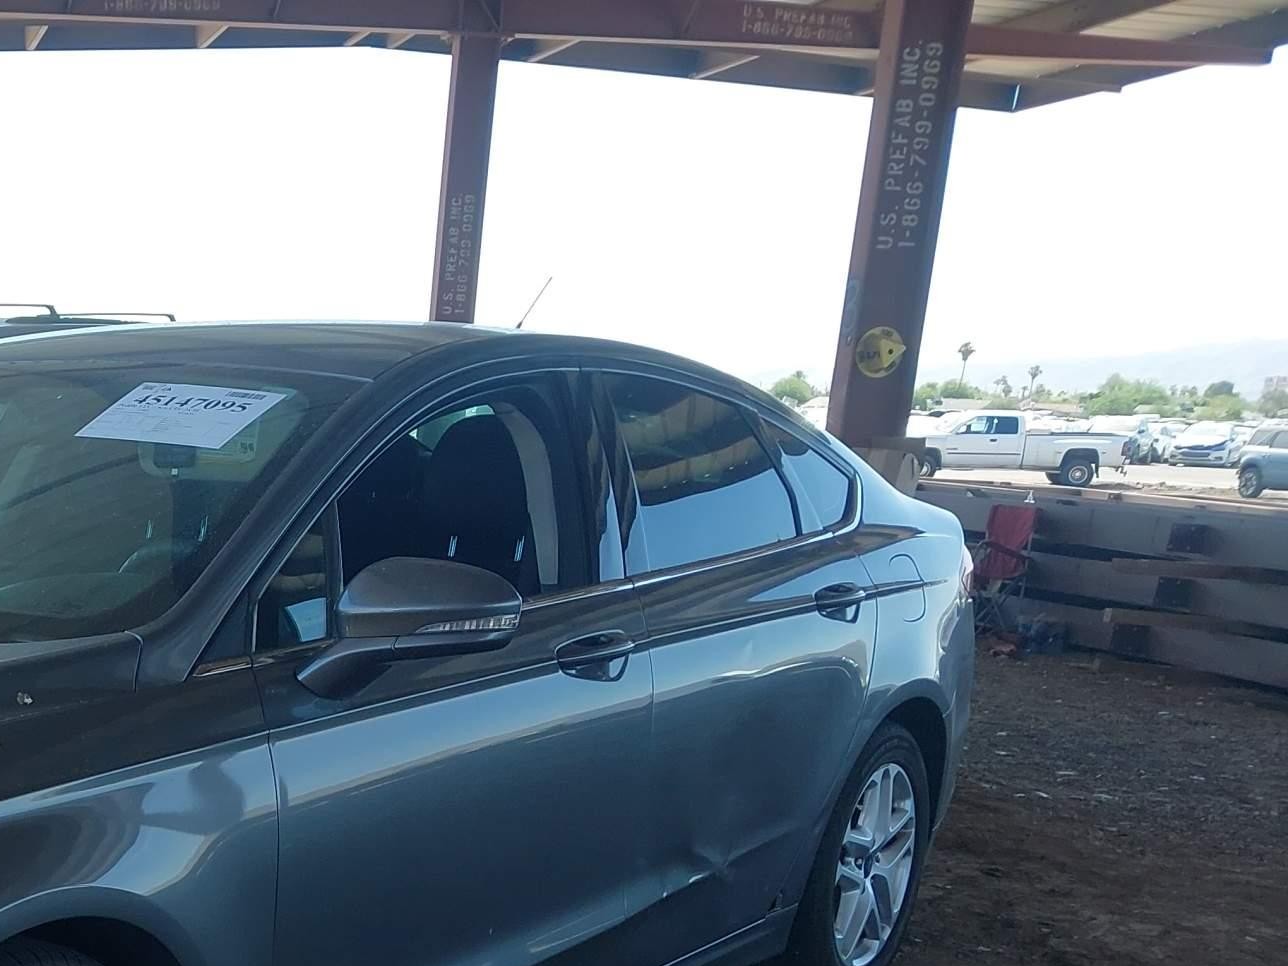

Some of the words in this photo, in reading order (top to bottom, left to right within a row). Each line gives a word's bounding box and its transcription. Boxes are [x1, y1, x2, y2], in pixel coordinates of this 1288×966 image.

[899, 40, 922, 85] INC.
[885, 99, 913, 191] PREFAB
[898, 42, 944, 248] 1-866-799-0969
[876, 205, 899, 249] U.S.
[445, 227, 459, 281] PREFAB
[442, 289, 454, 315] U.S.
[133, 393, 253, 413] 45147095
